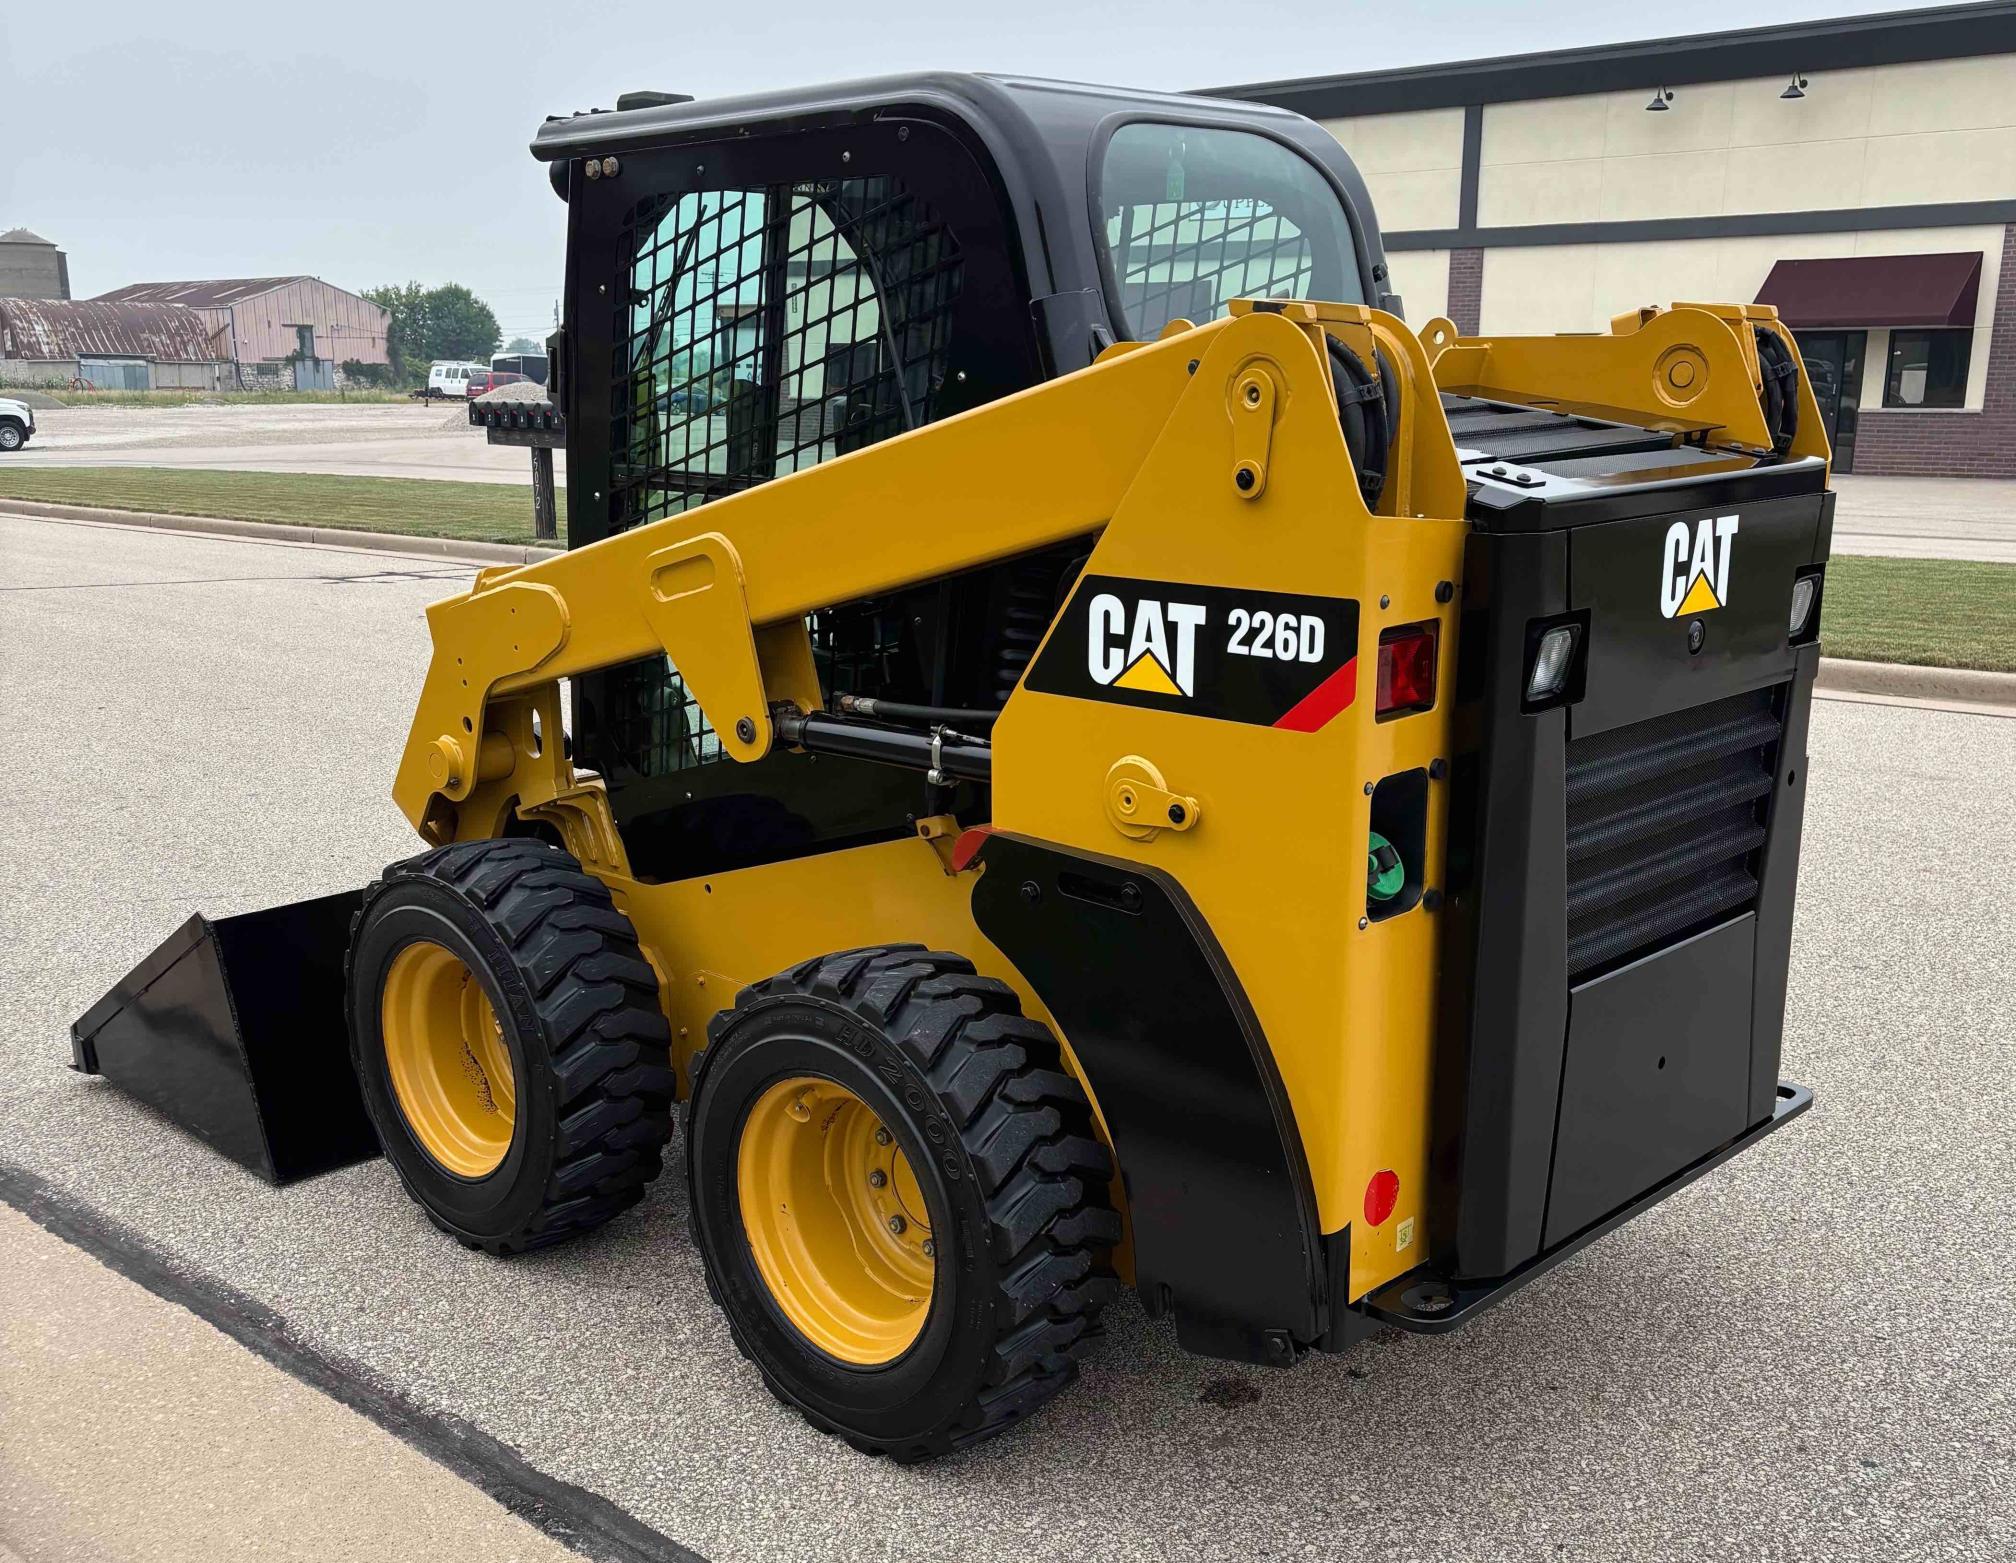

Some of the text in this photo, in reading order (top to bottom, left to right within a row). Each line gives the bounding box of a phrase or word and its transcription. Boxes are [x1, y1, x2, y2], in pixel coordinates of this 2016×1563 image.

[1660, 515, 1740, 619] CAT
[1088, 593, 1326, 698] CAT 226D
[878, 1056, 961, 1181] 2000
